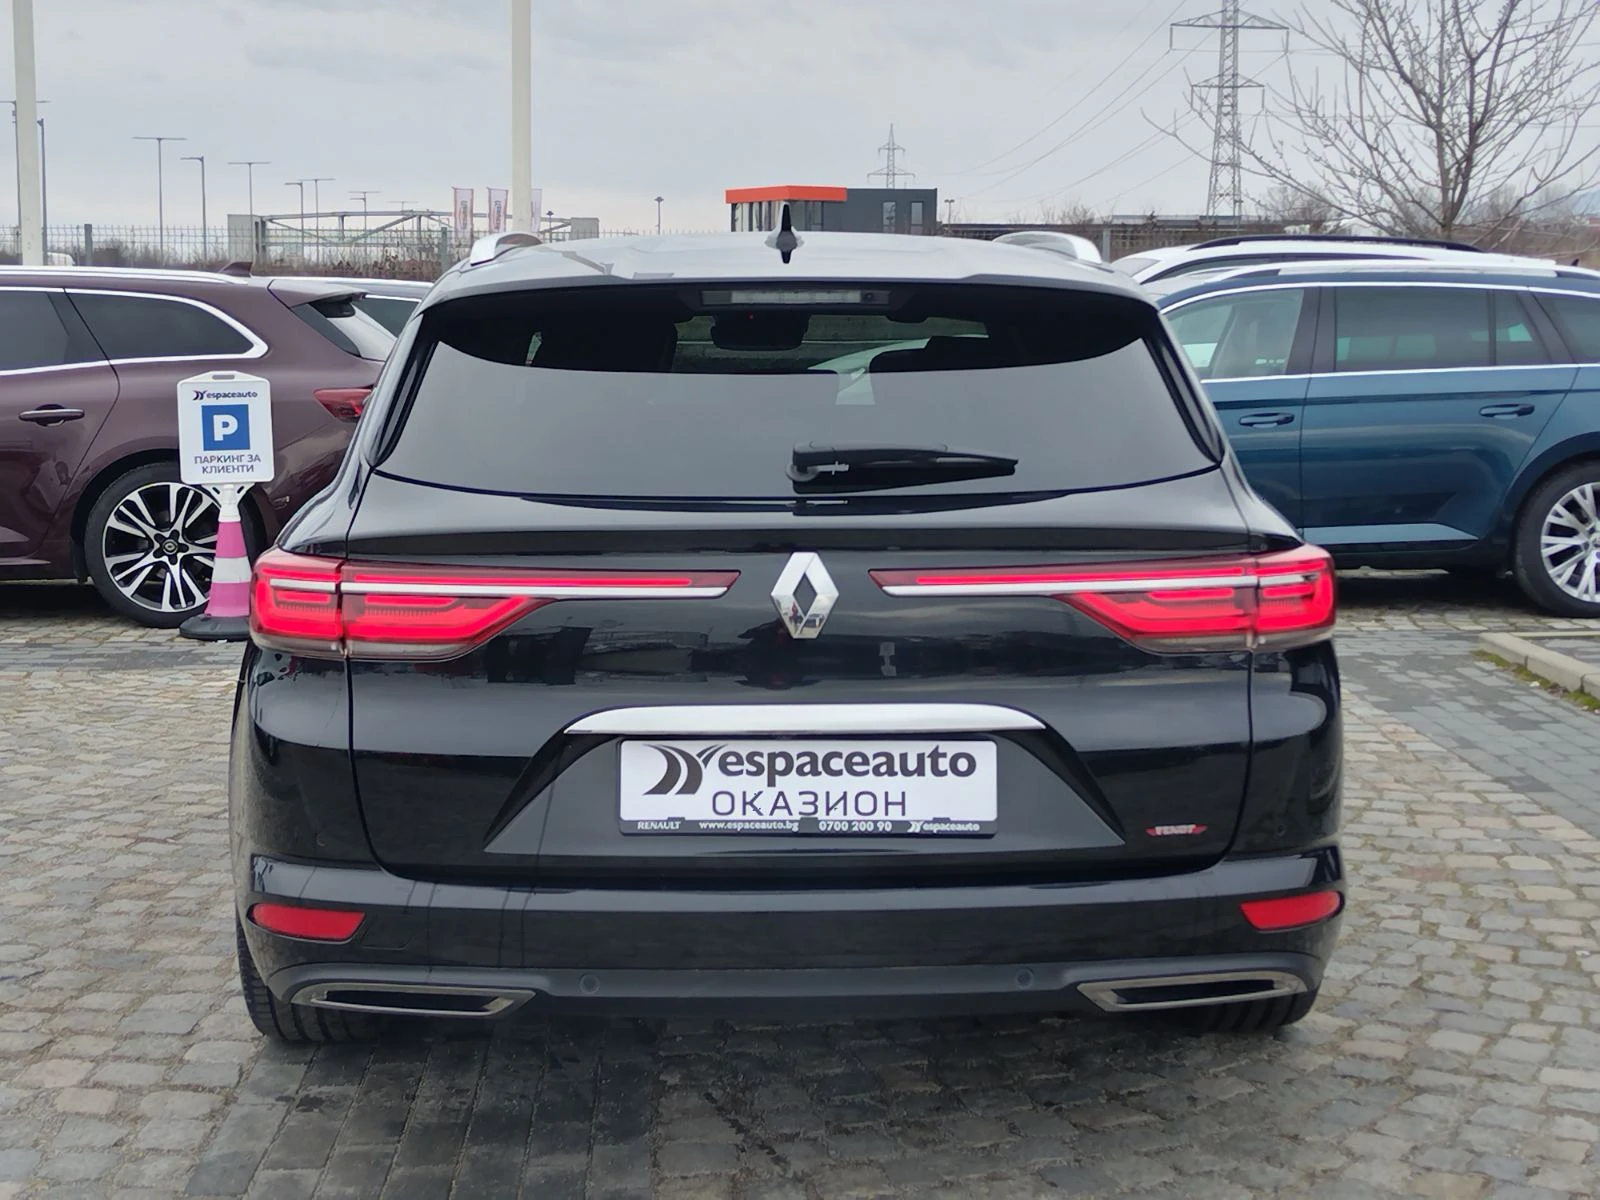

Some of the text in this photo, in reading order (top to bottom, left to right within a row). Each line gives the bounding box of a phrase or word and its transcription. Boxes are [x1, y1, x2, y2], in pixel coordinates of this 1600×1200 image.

[206, 391, 258, 400] espaceauto
[213, 414, 239, 442] P
[194, 454, 261, 464] ПАРКИНГ ЗА
[202, 465, 254, 474] КЛИЕНТИ
[718, 744, 977, 787] espaceauto
[712, 790, 906, 817] ОКАЗИОН
[637, 821, 980, 833] RENAULT www.espaceauto.bg 0700 200 90 espaceauto
